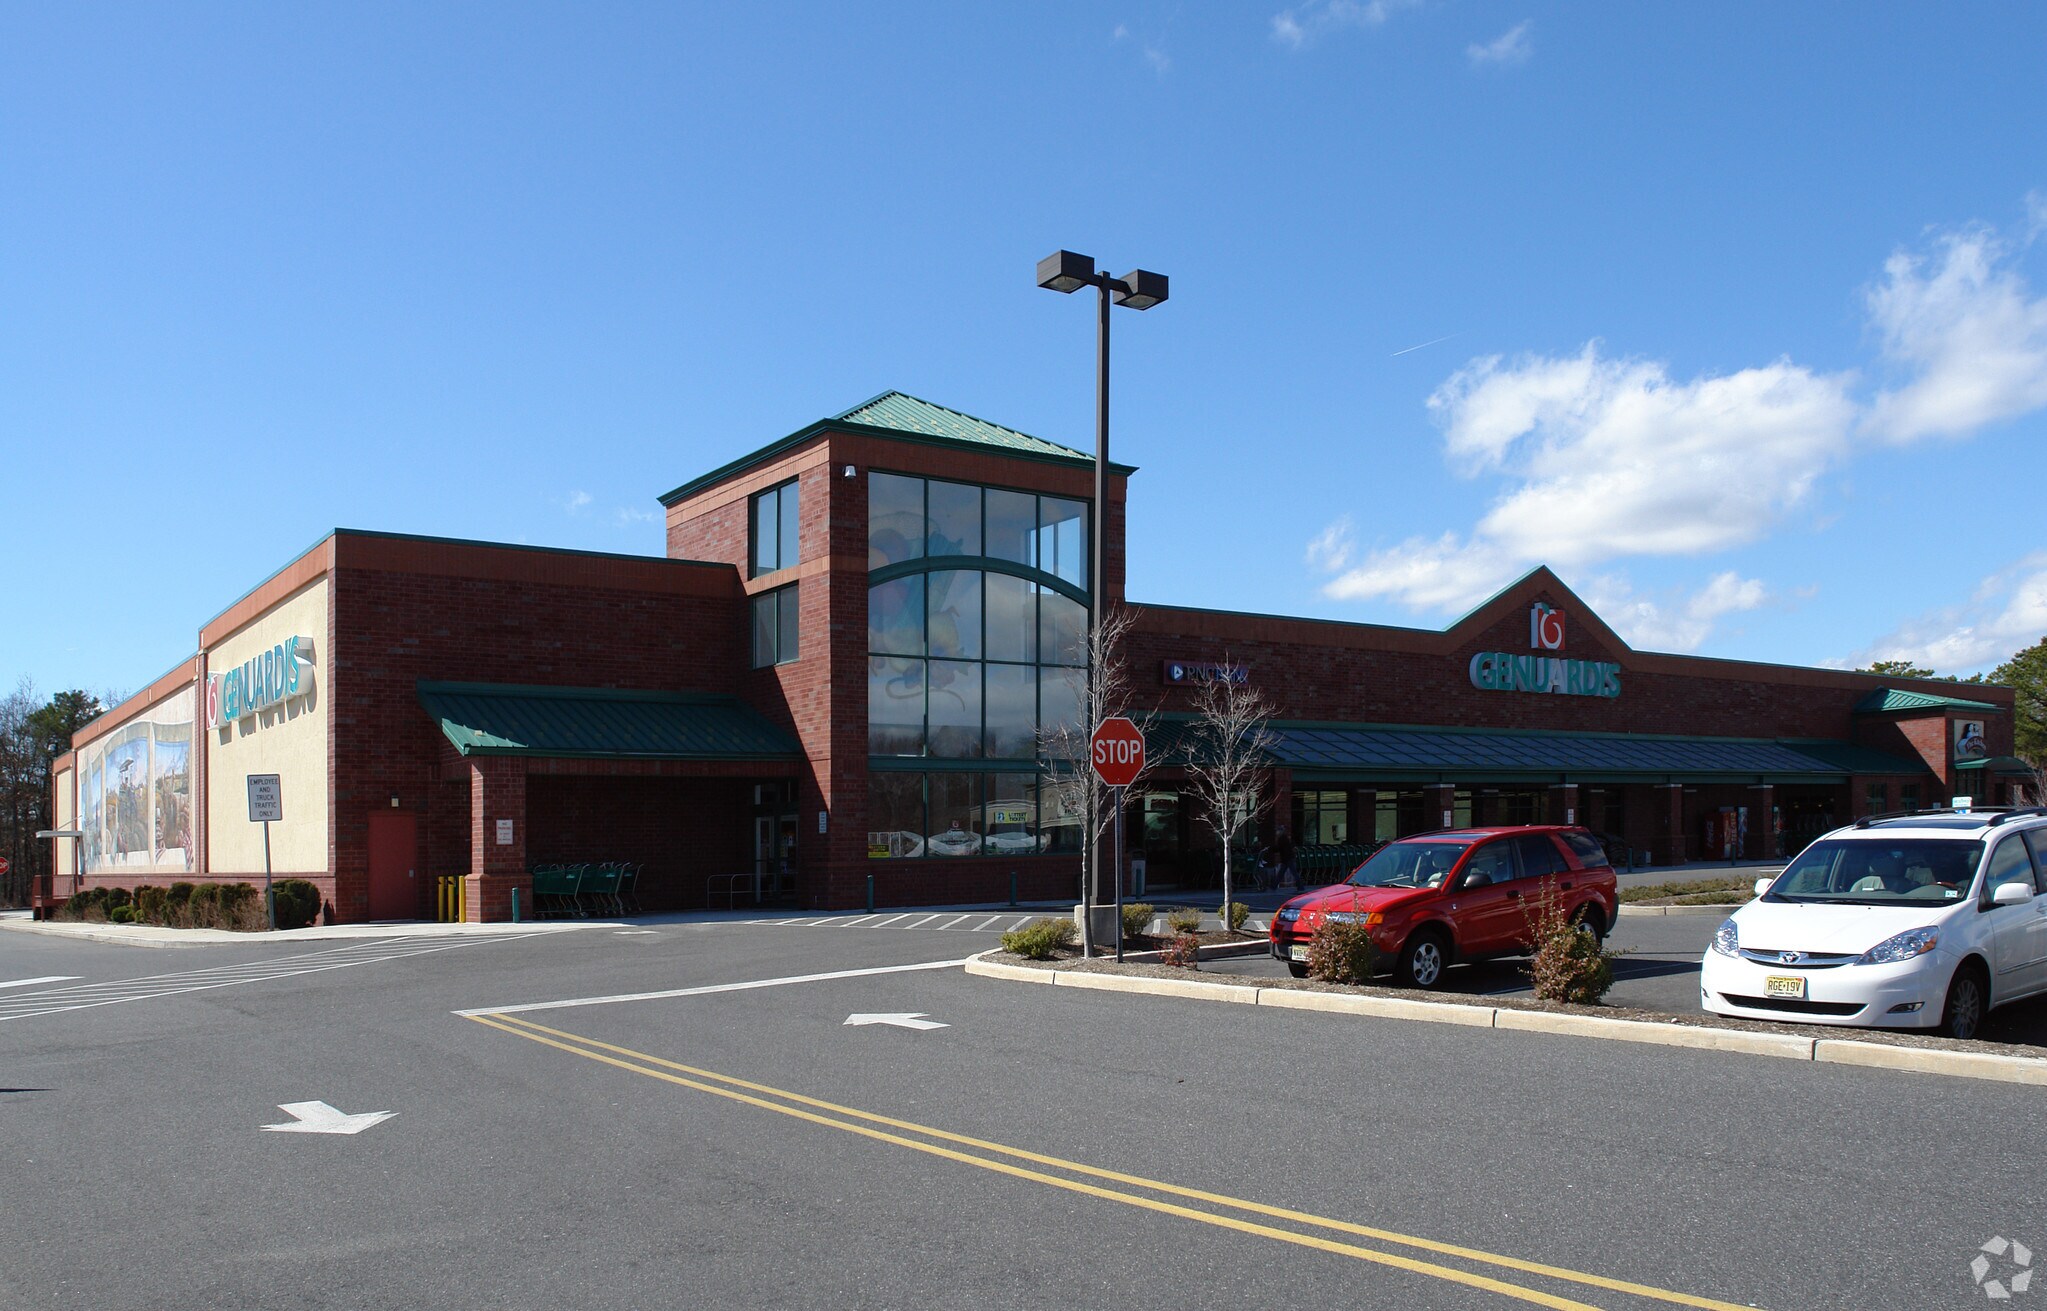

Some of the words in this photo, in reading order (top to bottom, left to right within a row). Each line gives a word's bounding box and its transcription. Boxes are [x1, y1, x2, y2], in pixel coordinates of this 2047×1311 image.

[223, 635, 304, 721] GENUARDI'S
[1469, 652, 1621, 698] GENUARDI'S
[1095, 739, 1141, 764] STOP
